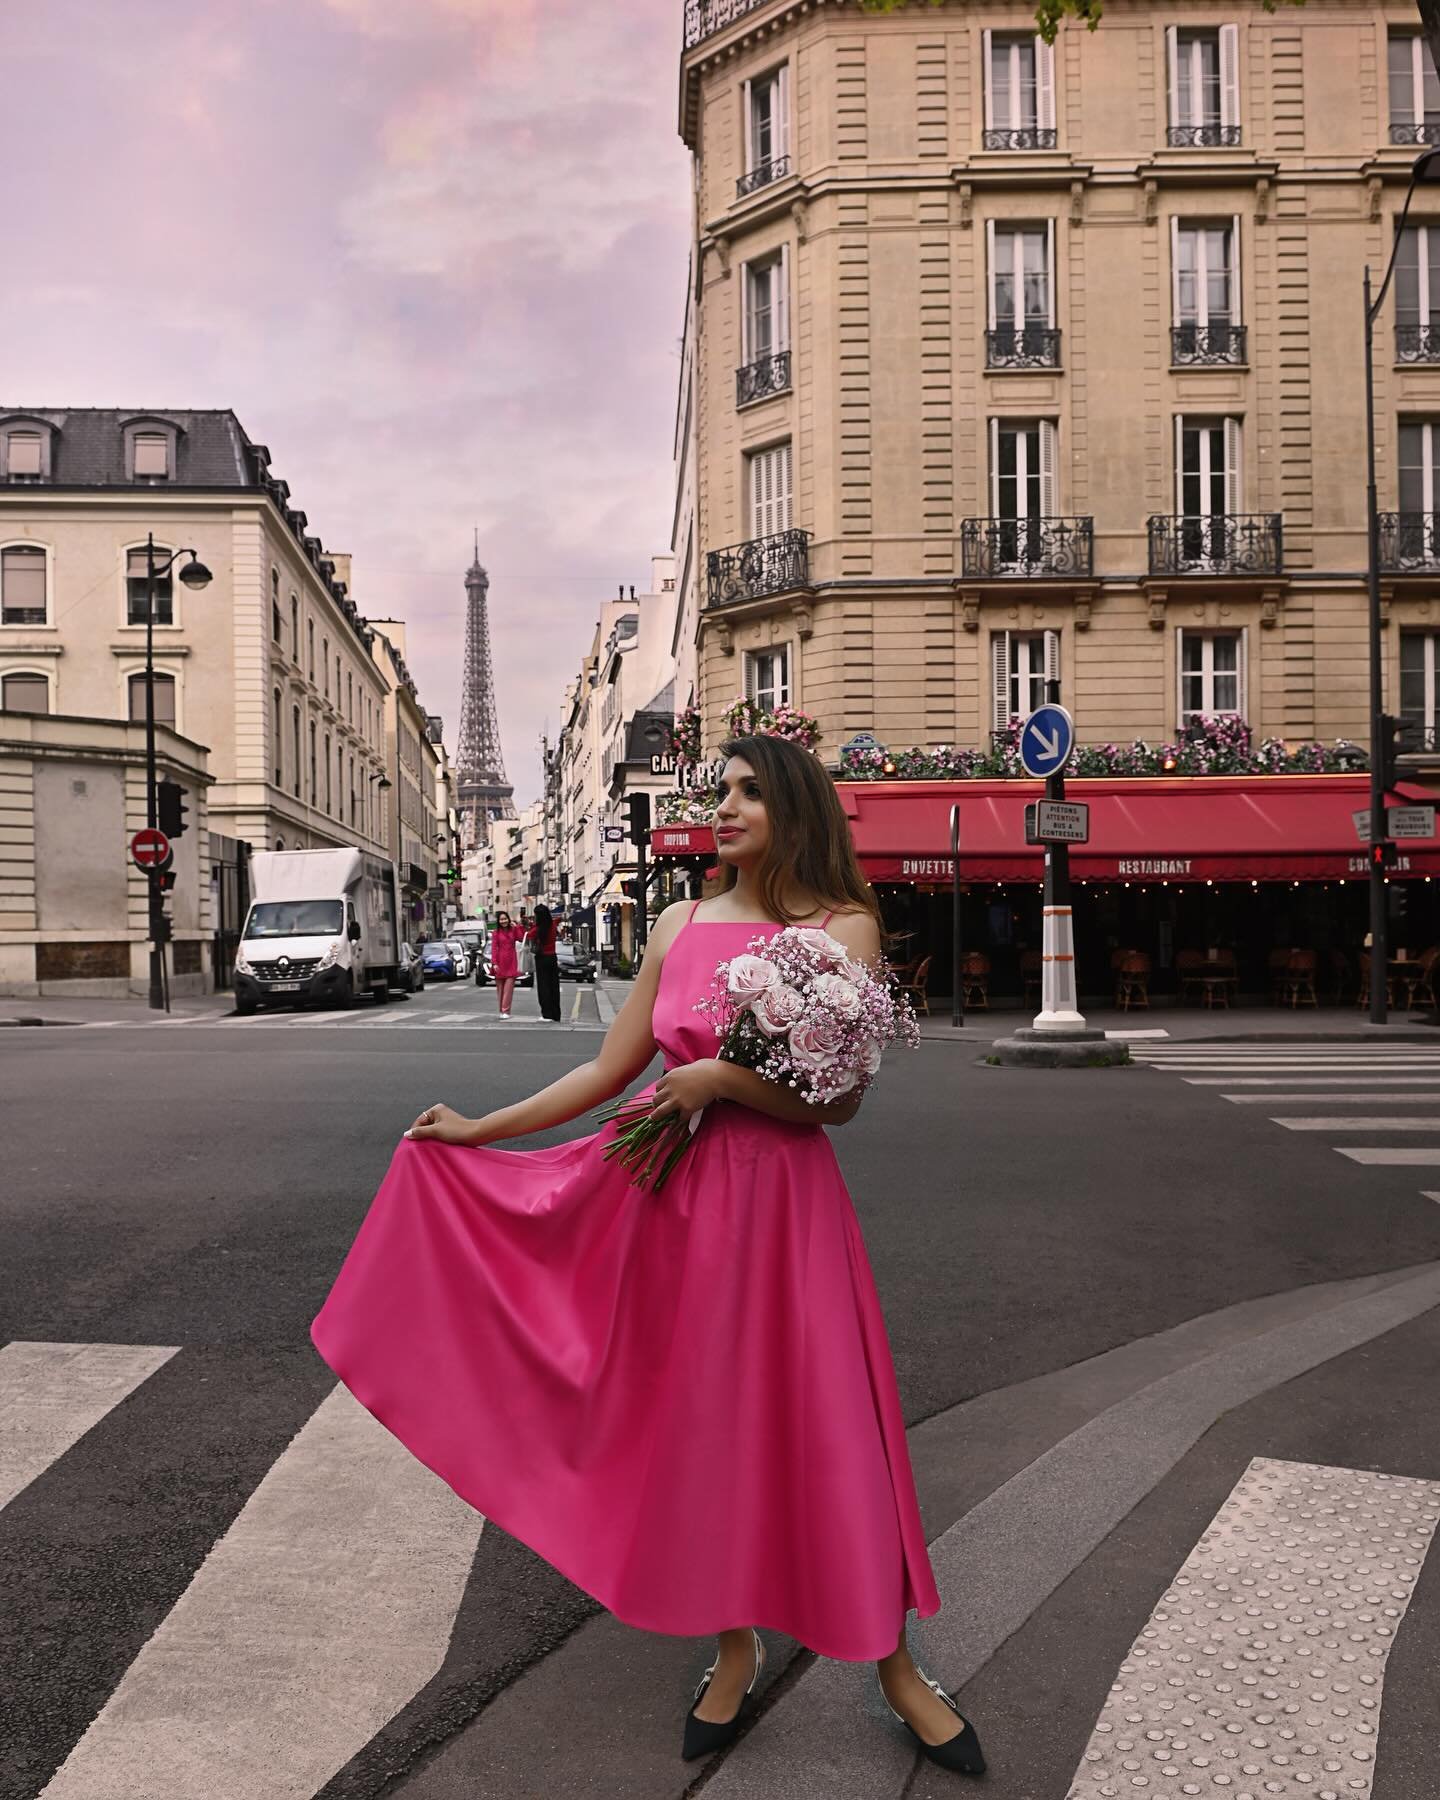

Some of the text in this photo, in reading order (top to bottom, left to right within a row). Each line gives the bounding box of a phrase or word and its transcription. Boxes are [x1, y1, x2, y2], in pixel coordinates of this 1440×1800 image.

[652, 755, 677, 772] CAF
[1046, 814, 1080, 822] ATTENTION
[1042, 829, 1084, 838] CONTRESENS
[1119, 860, 1192, 874] RESTAURANT
